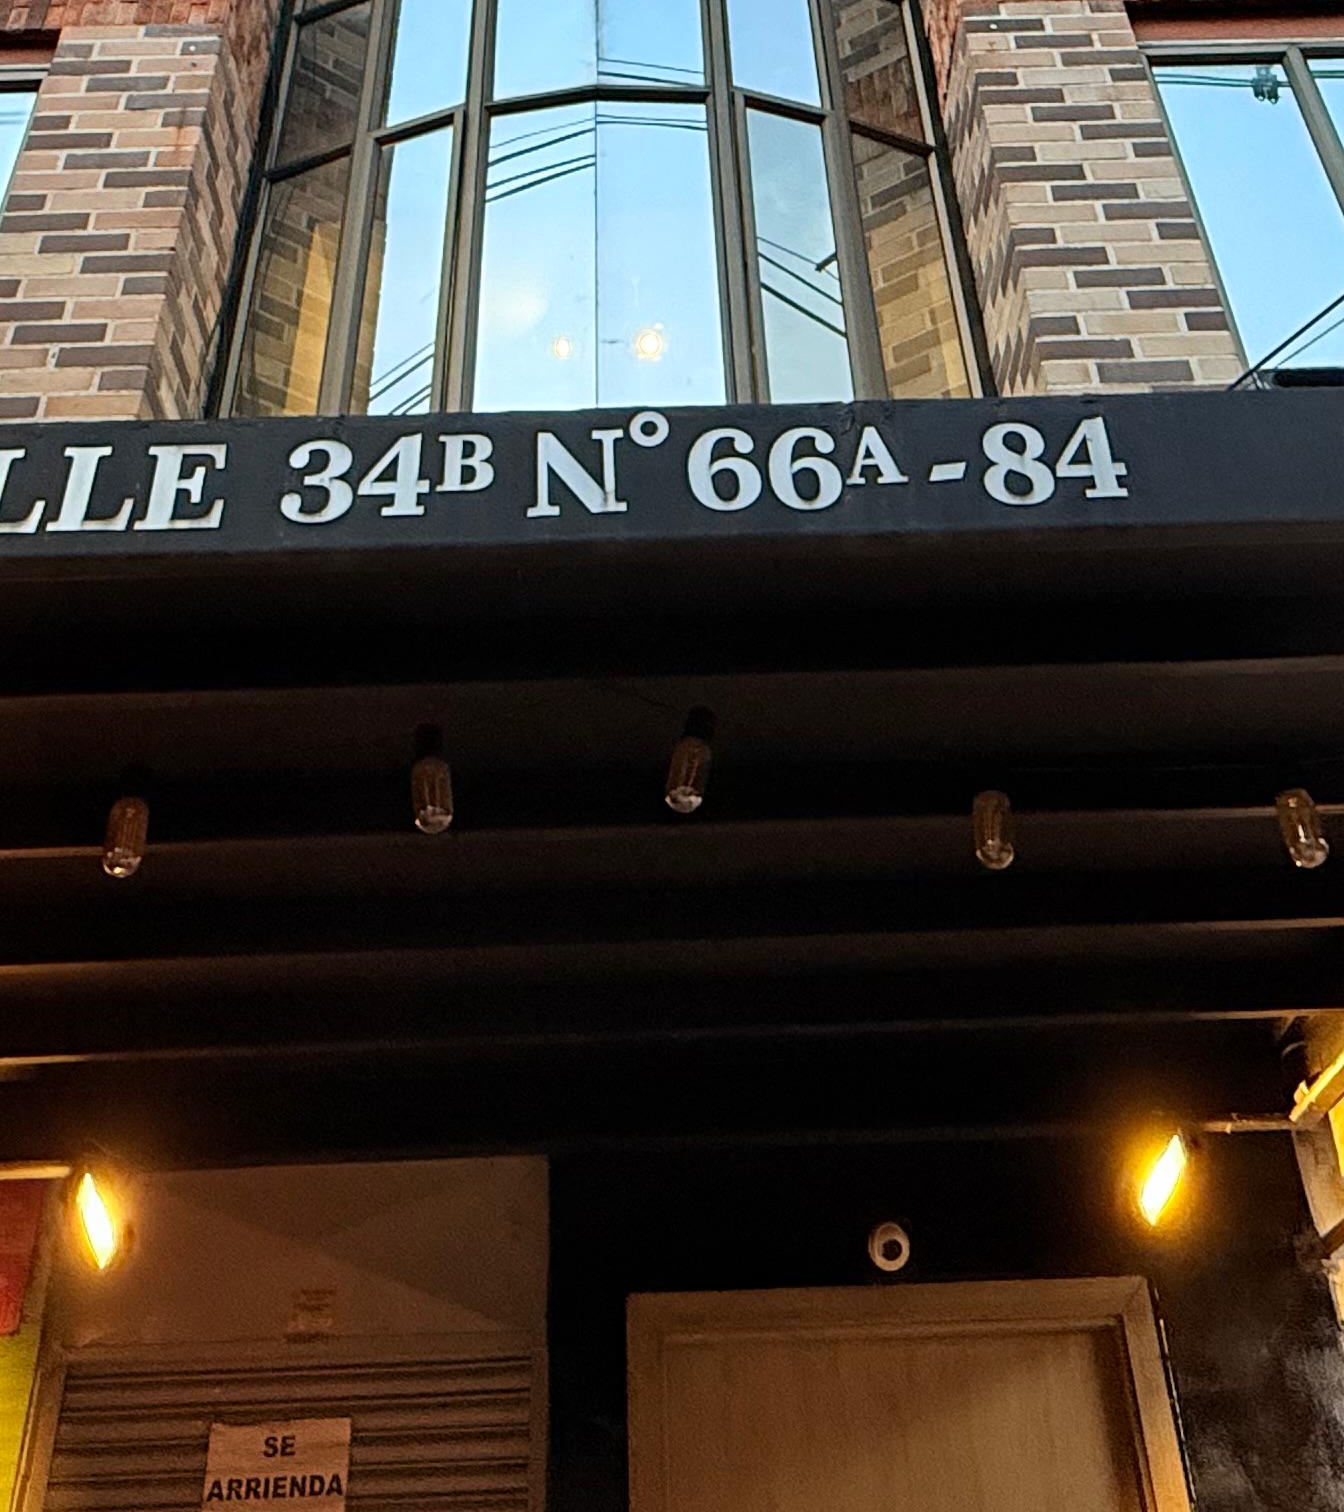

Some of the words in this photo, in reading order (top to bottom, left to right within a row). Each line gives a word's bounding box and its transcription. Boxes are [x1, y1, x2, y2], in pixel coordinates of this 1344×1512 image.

[279, 432, 495, 525] 34B
[262, 1434, 297, 1458] SE
[206, 1473, 344, 1502] ARRIENDA
